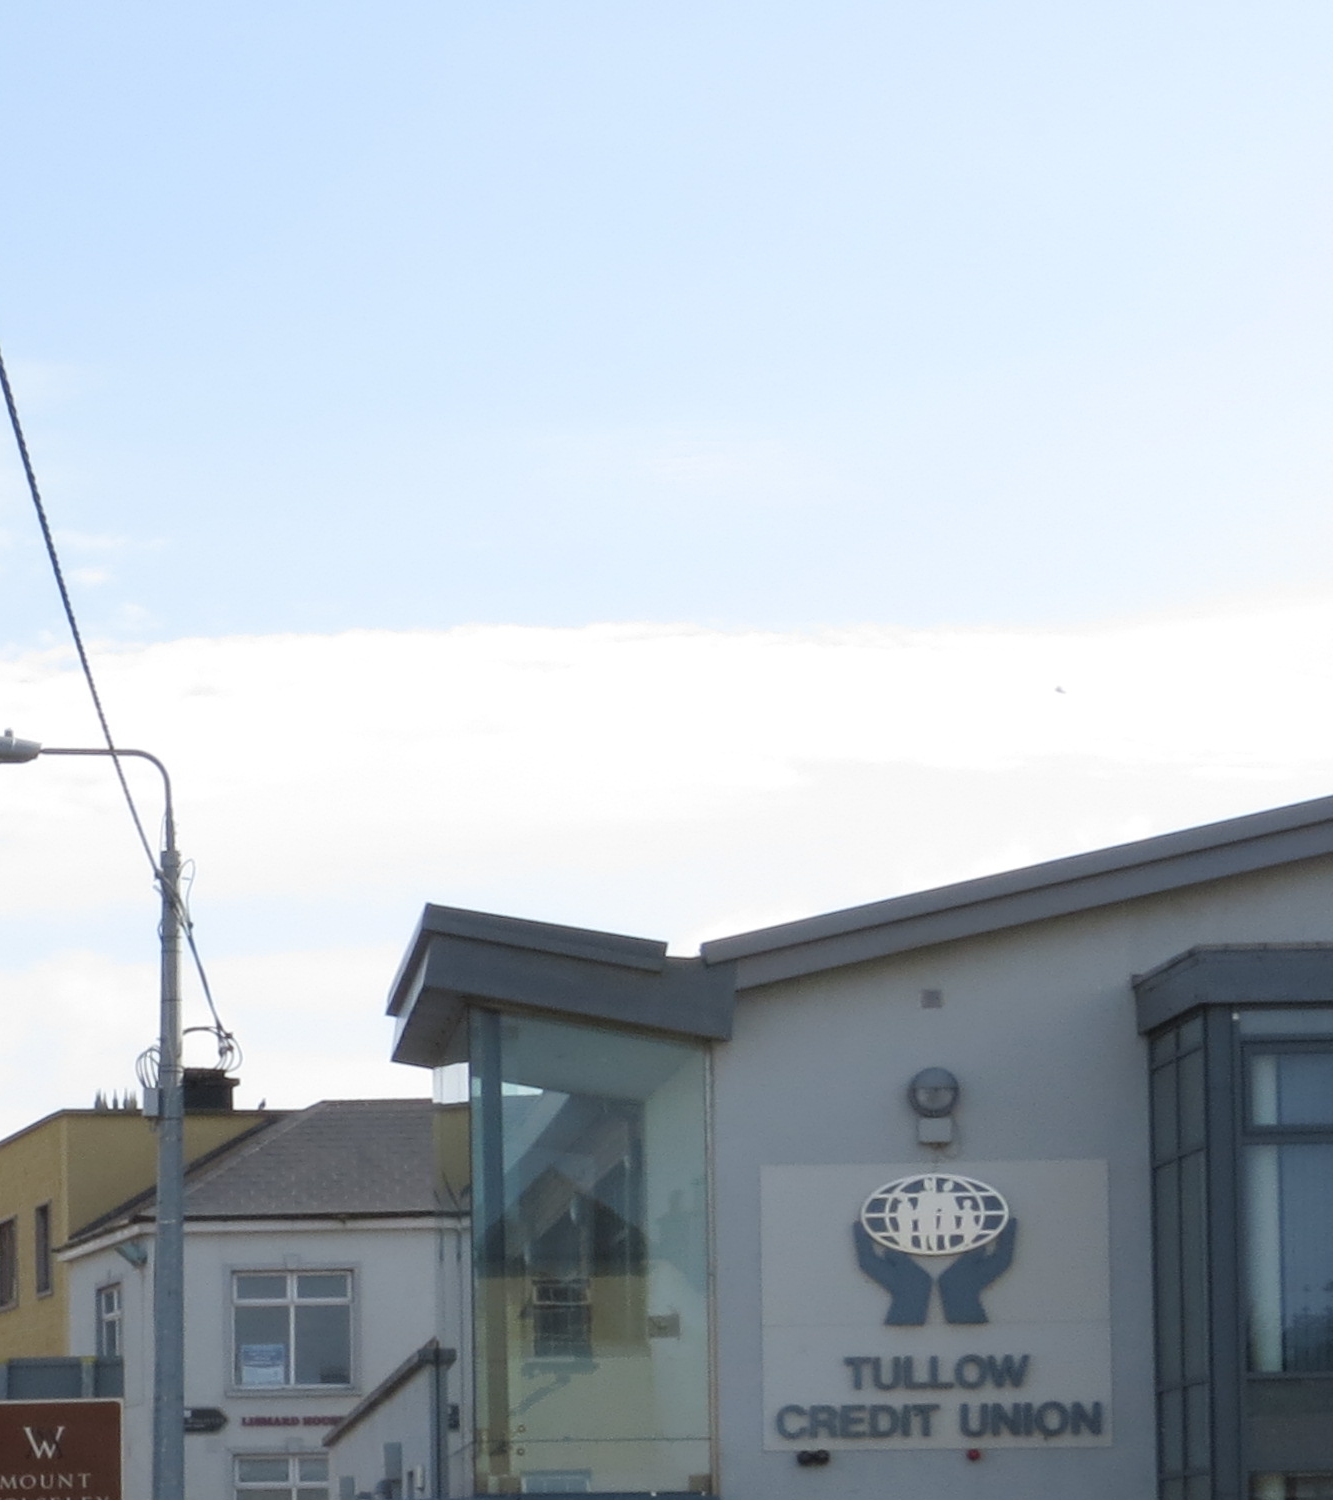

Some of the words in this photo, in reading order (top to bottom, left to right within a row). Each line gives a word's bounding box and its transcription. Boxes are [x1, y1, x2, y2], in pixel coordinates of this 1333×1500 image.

[843, 1354, 1031, 1390] TULLOW
[775, 1403, 941, 1439] CREDIT
[959, 1401, 1102, 1438] UNION
[23, 1426, 65, 1459] W
[0, 1473, 91, 1490] MOUNT
